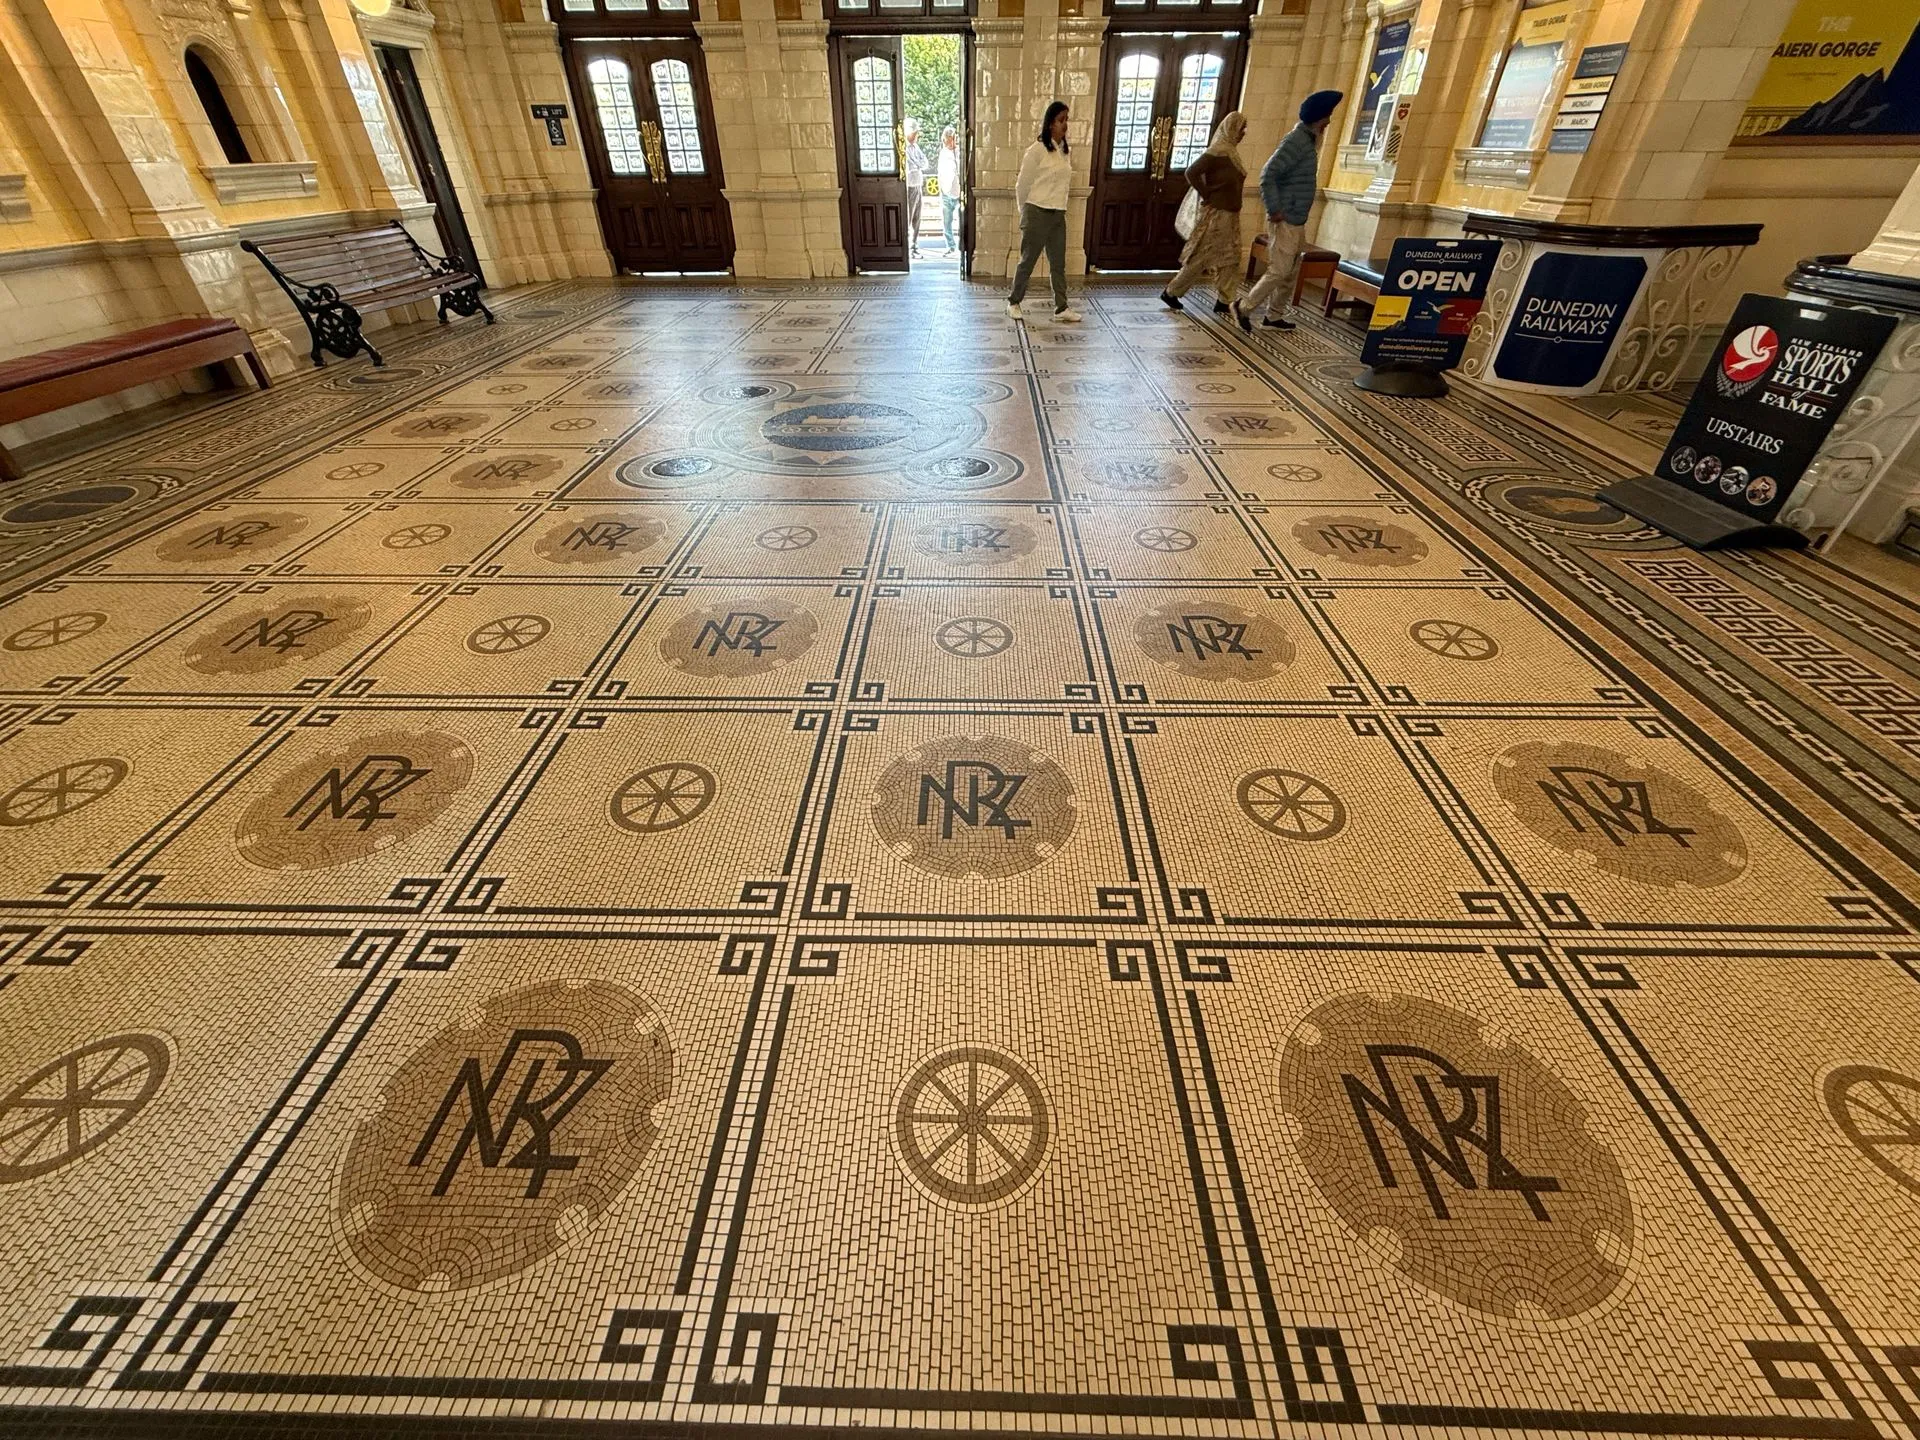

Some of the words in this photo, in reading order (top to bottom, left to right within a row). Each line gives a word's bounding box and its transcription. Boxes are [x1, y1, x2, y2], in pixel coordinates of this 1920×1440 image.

[1771, 41, 1818, 58] AIERI
[1818, 41, 1882, 58] GORGE
[1571, 100, 1594, 108] MONDAY
[1405, 250, 1443, 259] DUNEDIN
[1444, 252, 1483, 261] RAILWAYS
[1397, 270, 1477, 293] OPEN
[1526, 297, 1618, 318] DUNEDIN
[1520, 313, 1611, 335] RAILWAYS
[1790, 337, 1813, 348] NEW
[1816, 342, 1864, 358] ZEALAND
[1778, 344, 1857, 384] SPORTS
[1770, 371, 1838, 398] HALL
[1791, 390, 1806, 400] of
[1759, 391, 1827, 420] FAME
[1706, 417, 1784, 455] UPSTAIRS
